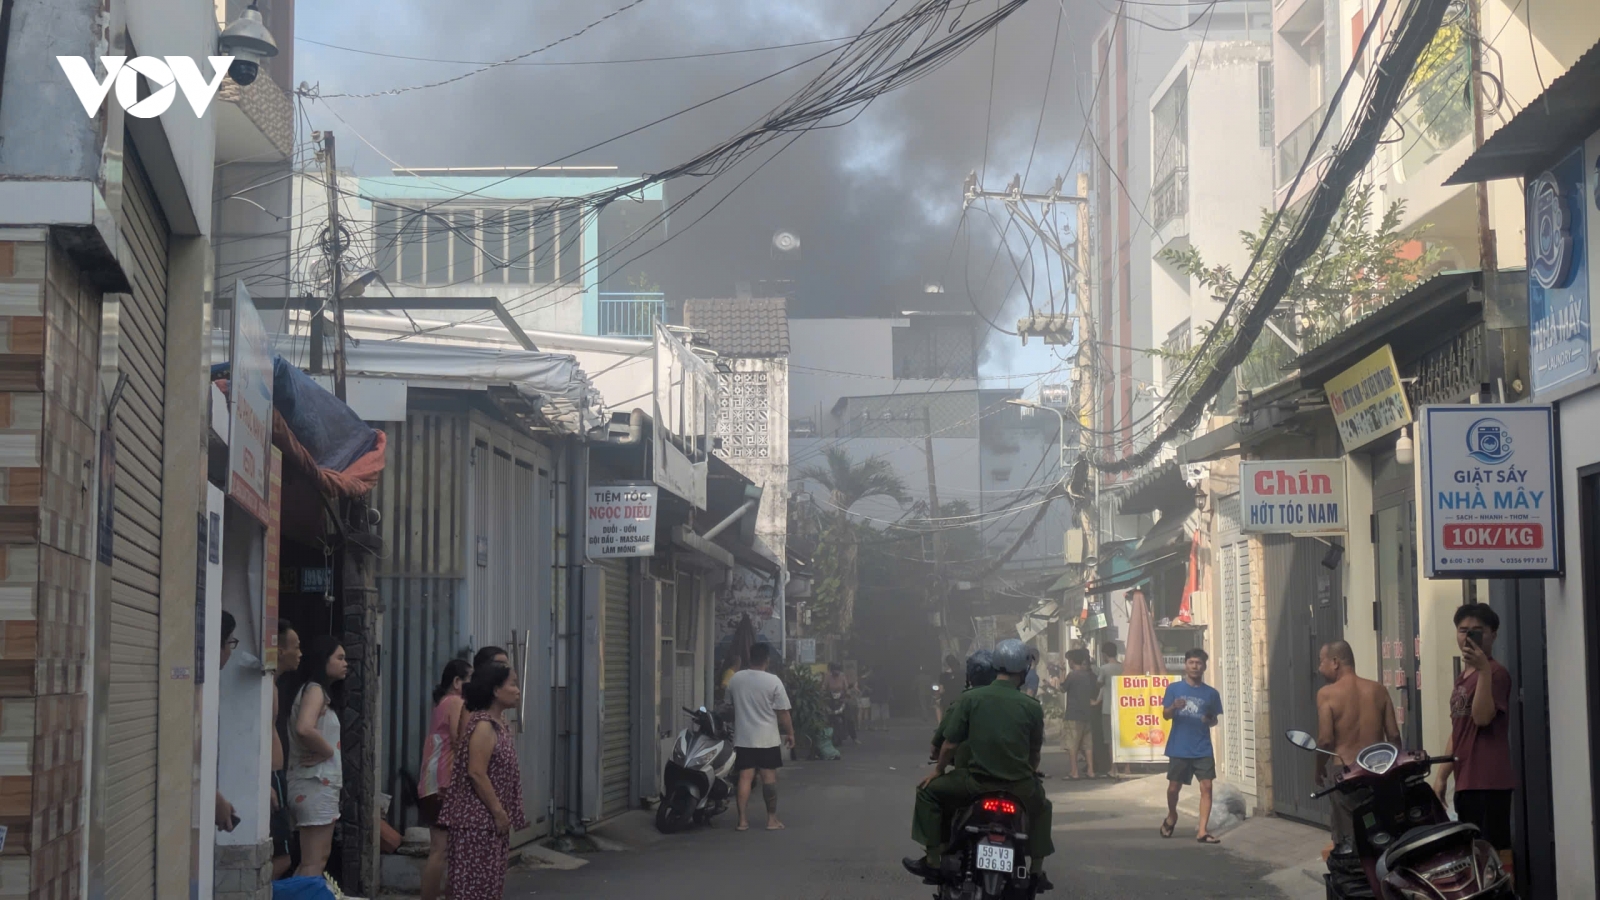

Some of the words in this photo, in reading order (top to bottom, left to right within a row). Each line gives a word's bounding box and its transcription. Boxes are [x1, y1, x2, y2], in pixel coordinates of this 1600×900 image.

[1535, 305, 1558, 354] NHÀ
[1559, 294, 1583, 341] MÂY
[1547, 348, 1572, 371] LAUNDRY
[1254, 469, 1332, 495] Chín
[1454, 467, 1493, 486] GIẶT
[1496, 464, 1528, 483] SẤY
[594, 490, 621, 505] TIỆM
[624, 490, 647, 502] TÓC
[1438, 486, 1487, 510] NHÀ
[1494, 486, 1544, 510] MÂY
[589, 506, 621, 523] NGỌC
[1250, 500, 1275, 525] HỚT
[1278, 499, 1303, 524] TÓC
[1307, 503, 1338, 523] NAM
[1456, 514, 1473, 522] SẠCH
[589, 536, 600, 545] GỘI
[620, 535, 650, 543] MASSAGE
[1452, 528, 1534, 546] 10K/KG
[602, 546, 616, 554] LÀM
[617, 545, 636, 553] MÓNG
[1123, 676, 1148, 688] Bún
[1152, 676, 1169, 688] Bò
[1120, 694, 1145, 707] Chả
[1136, 715, 1160, 726] 35k
[982, 846, 1009, 859] 59-V3
[979, 857, 1012, 872] 036.93
